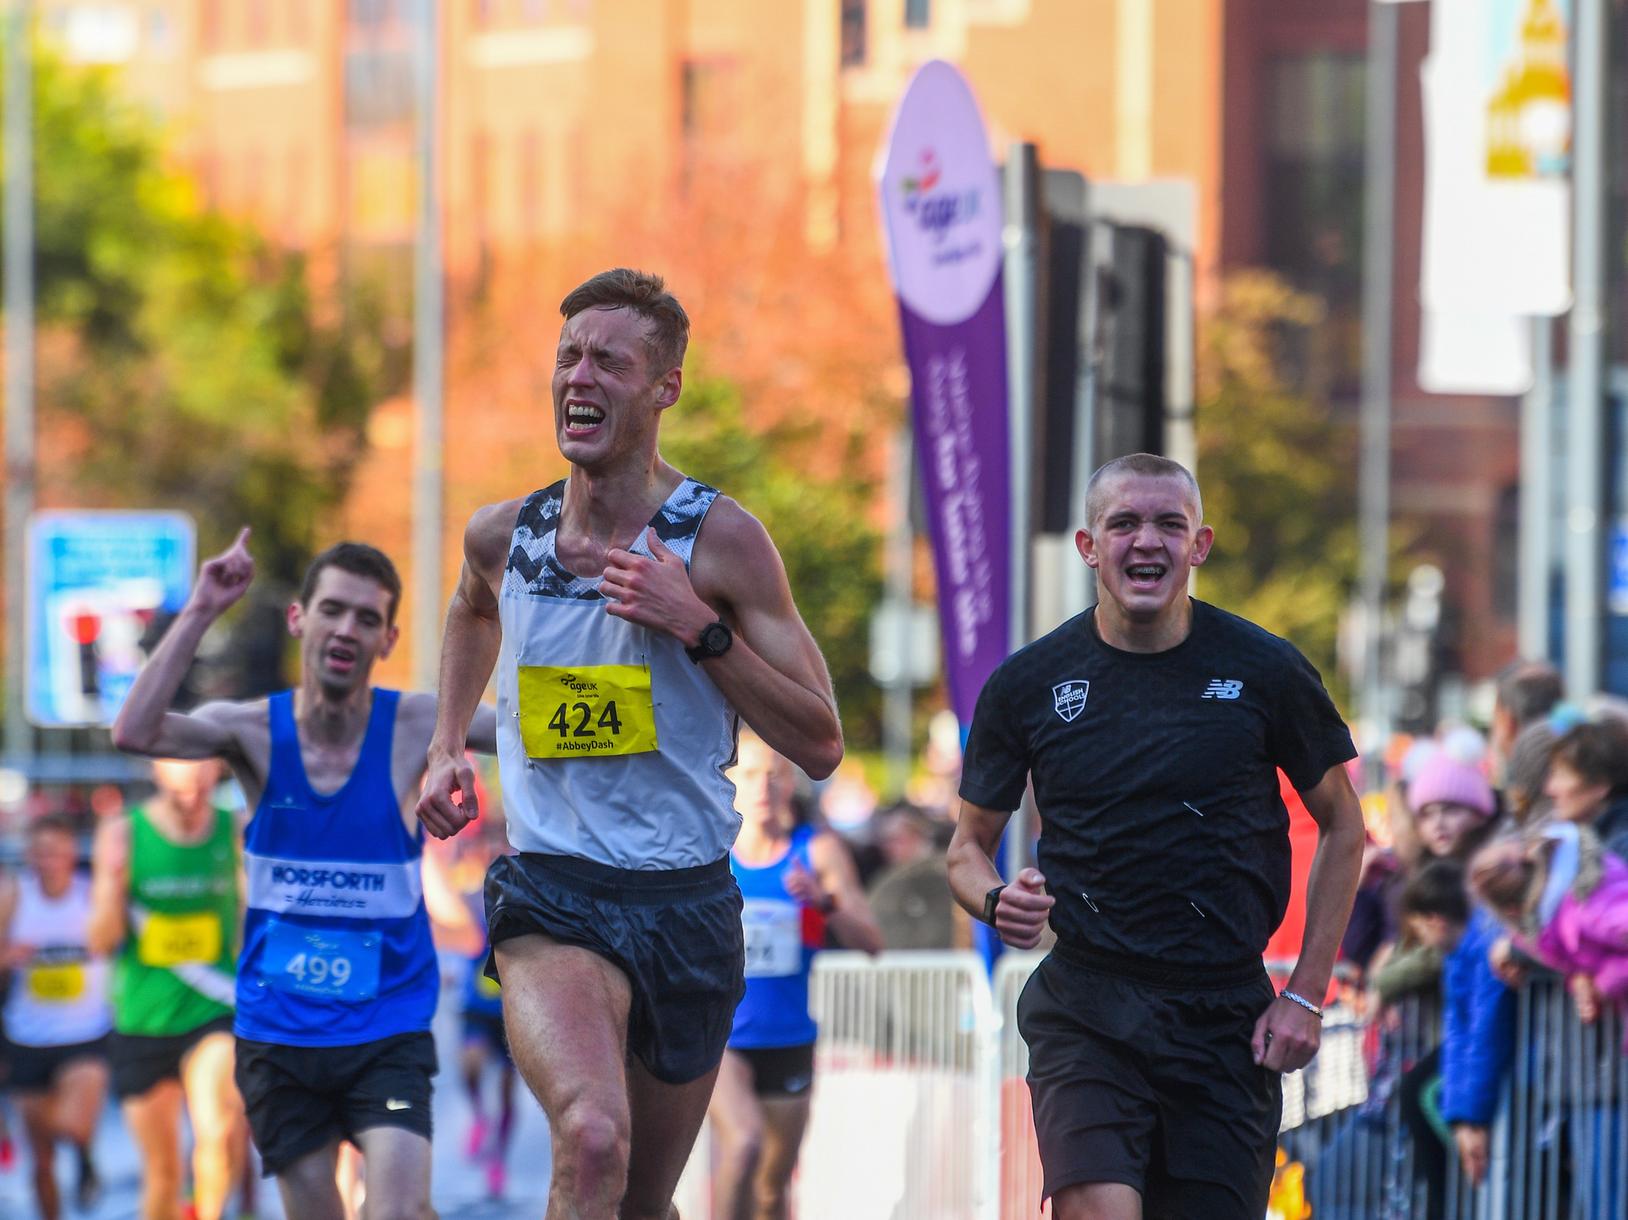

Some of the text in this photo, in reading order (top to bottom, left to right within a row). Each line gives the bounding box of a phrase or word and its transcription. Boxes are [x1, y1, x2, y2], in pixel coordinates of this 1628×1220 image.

[1201, 679, 1243, 699] NB
[548, 701, 622, 737] 424
[556, 739, 614, 751] #AbbeyDash
[271, 866, 385, 892] HORSFORTH
[286, 952, 351, 987] 499
